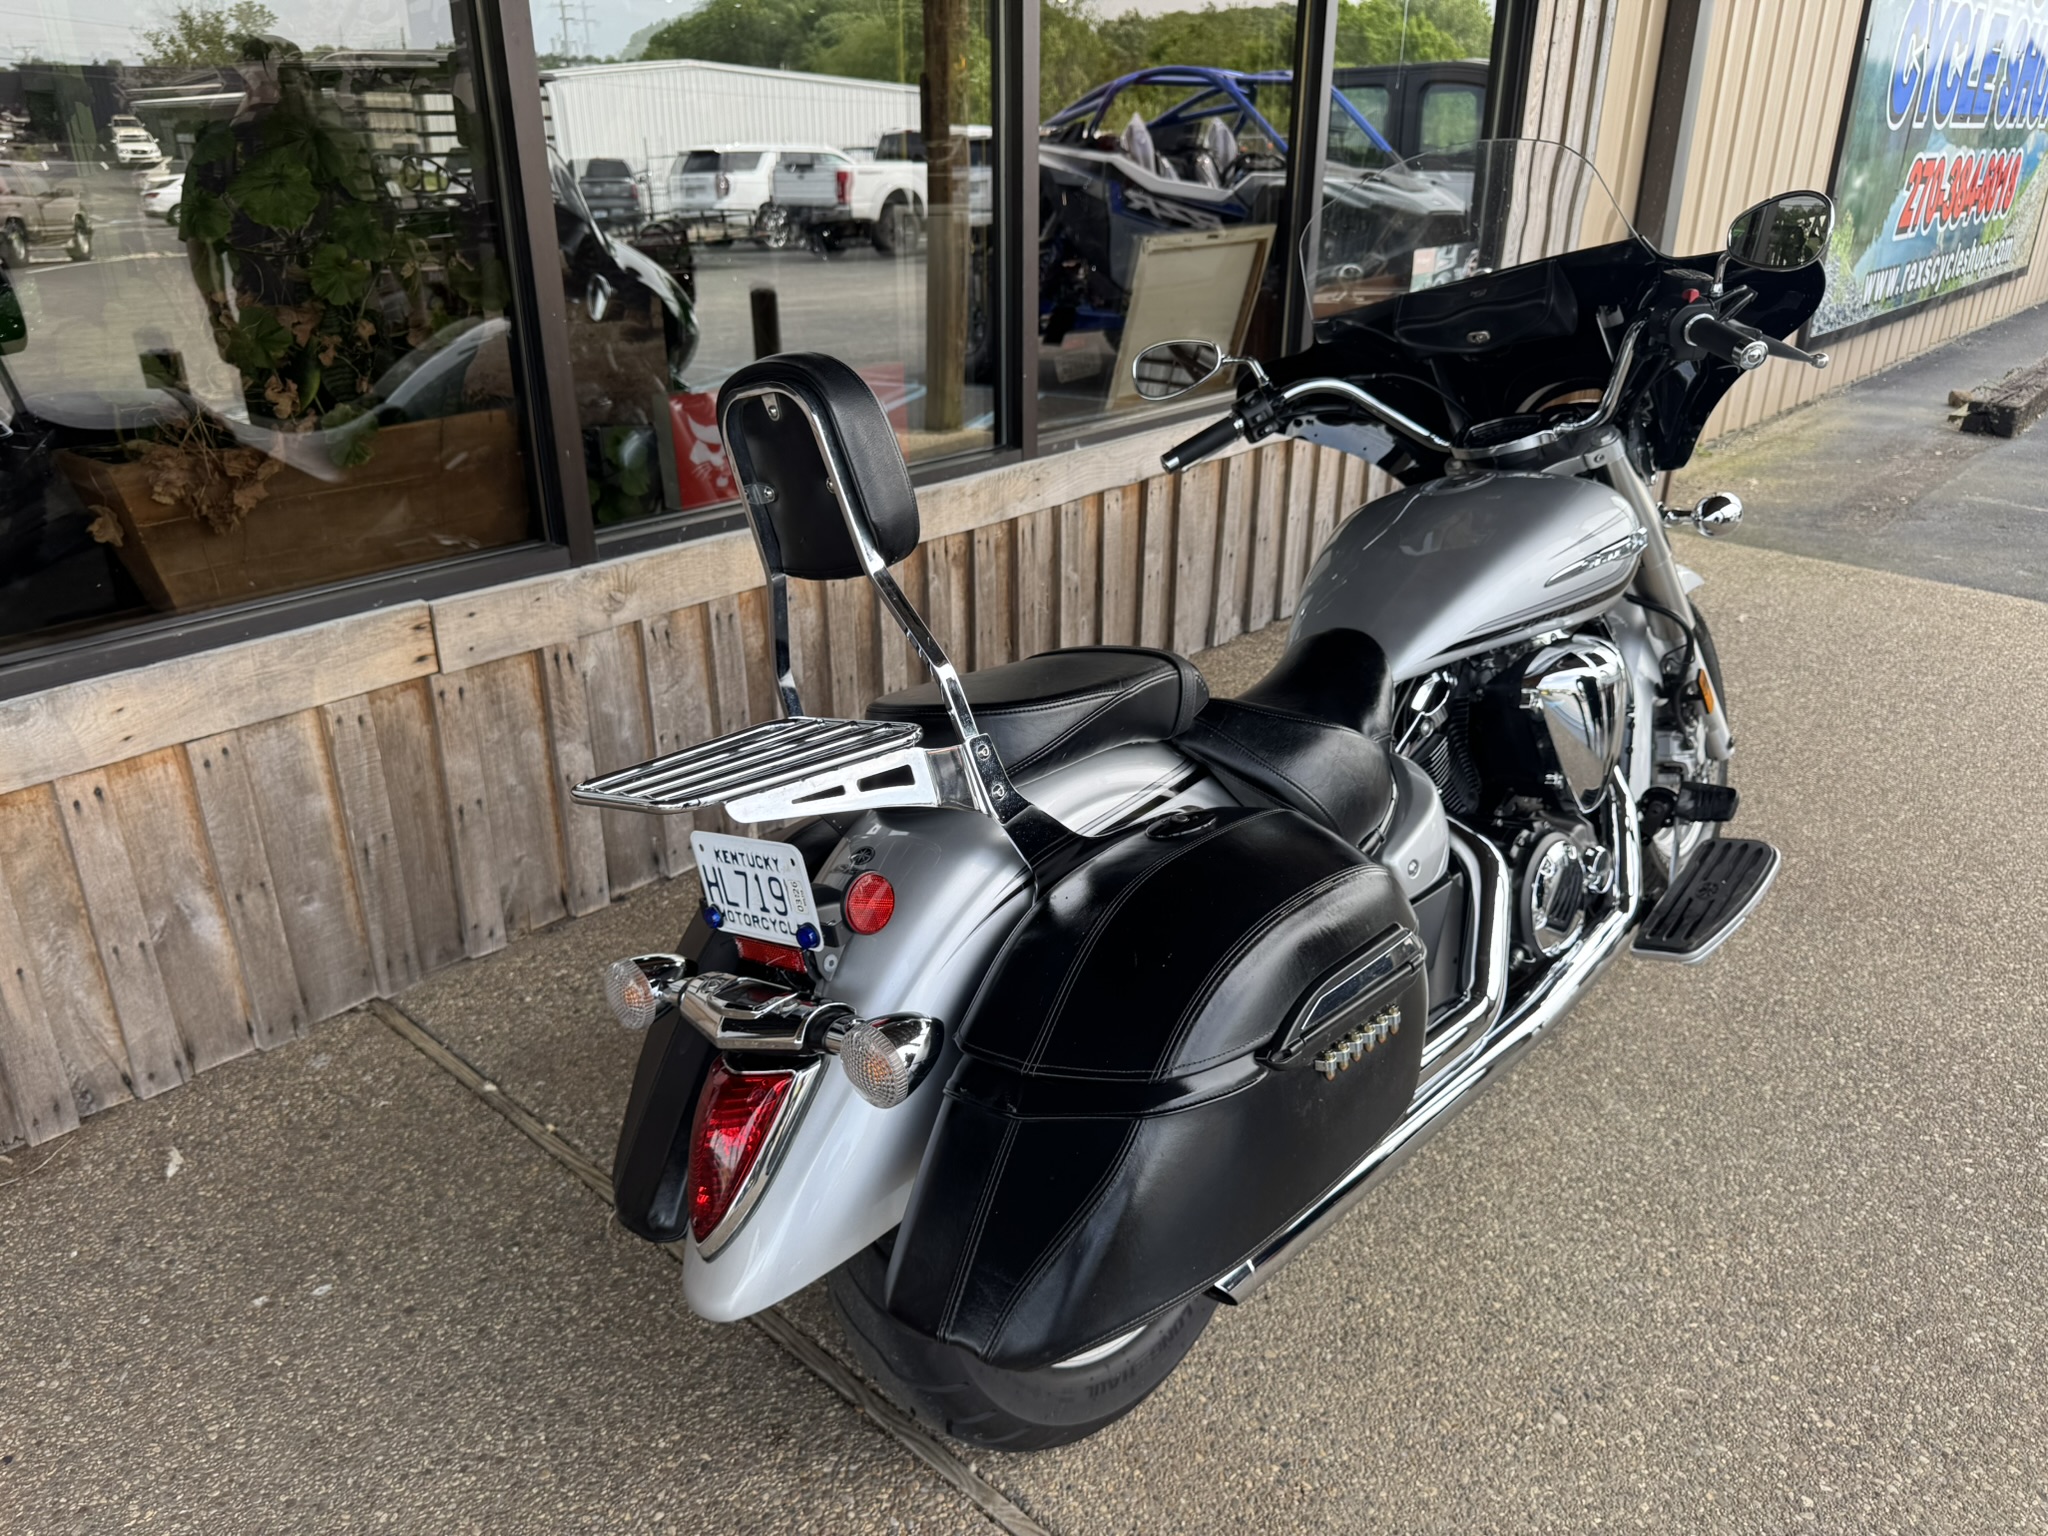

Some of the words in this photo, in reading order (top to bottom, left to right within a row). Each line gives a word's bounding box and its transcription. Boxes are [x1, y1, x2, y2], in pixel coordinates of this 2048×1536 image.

[1886, 0, 2008, 131] CYCLE
[1994, 14, 2048, 131] SHO
[1892, 147, 2024, 242] 270-384-6018
[1862, 236, 2014, 307] www.rexscycleshop.com
[702, 864, 788, 917] HL719
[714, 848, 780, 873] KENTUCKY
[721, 906, 801, 937] OTORCYCL
